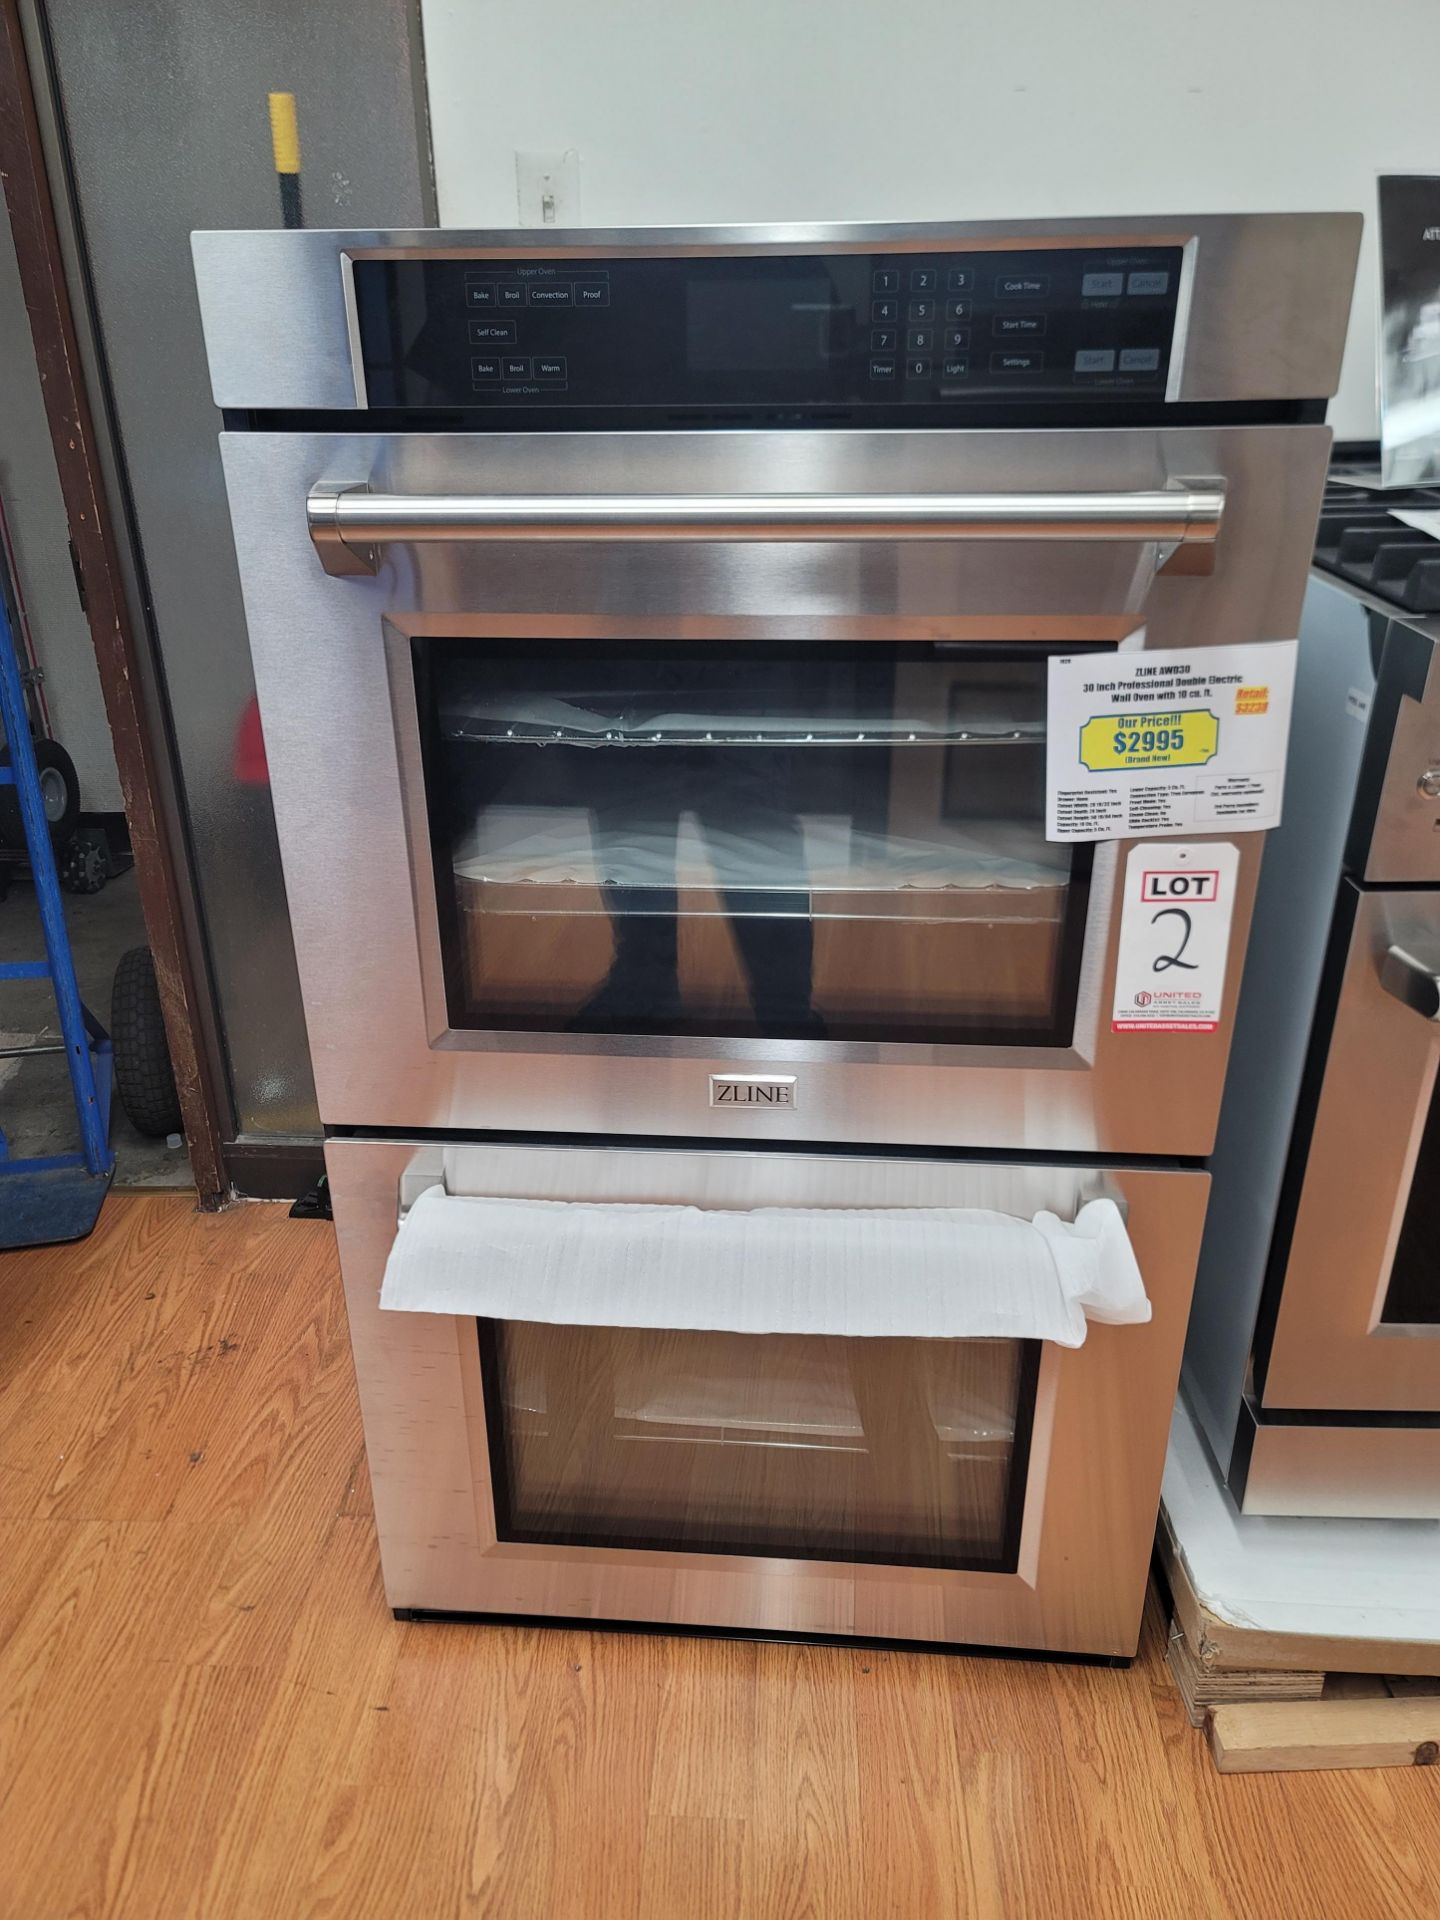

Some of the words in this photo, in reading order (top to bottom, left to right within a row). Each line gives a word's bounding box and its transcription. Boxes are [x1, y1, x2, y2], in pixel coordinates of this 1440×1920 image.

[884, 276, 888, 288] 1
[920, 275, 928, 287] 2
[958, 274, 965, 286] 3
[1004, 282, 1022, 290] Cook
[1022, 282, 1041, 290] Time
[473, 291, 490, 300] Bake
[504, 291, 520, 299] Broil
[532, 291, 569, 299] Convection
[583, 290, 601, 298] Proof
[881, 306, 888, 316] 4
[918, 304, 926, 316] 5
[956, 304, 964, 316] 6
[1002, 320, 1020, 330] Start
[1020, 320, 1037, 329] Time
[476, 328, 490, 336] Self
[490, 328, 508, 336] Clean
[880, 335, 888, 346] 7
[916, 334, 924, 346] 8
[954, 334, 962, 345] 9
[478, 364, 494, 372] Bake
[915, 363, 923, 374] 0
[1002, 358, 1030, 368] Settings
[872, 365, 892, 374] Timer
[946, 364, 965, 374] Light
[1135, 668, 1158, 677] ZLINE
[1083, 684, 1094, 692] 30
[1096, 682, 1116, 692] Inch
[1118, 678, 1174, 690] Professional
[1176, 676, 1206, 687] Double
[1208, 675, 1243, 685] Electric
[1111, 694, 1131, 703] Wall
[1133, 693, 1155, 702] Oven
[1156, 692, 1176, 700] with
[1118, 717, 1138, 729] Our
[1140, 714, 1182, 728] Price!!!
[1112, 729, 1184, 755] $2995
[1124, 755, 1150, 764] (Brand
[1152, 754, 1171, 763] New)
[1151, 876, 1210, 896] LOT
[1151, 908, 1199, 972] 2
[718, 1084, 789, 1102] ZLINE
